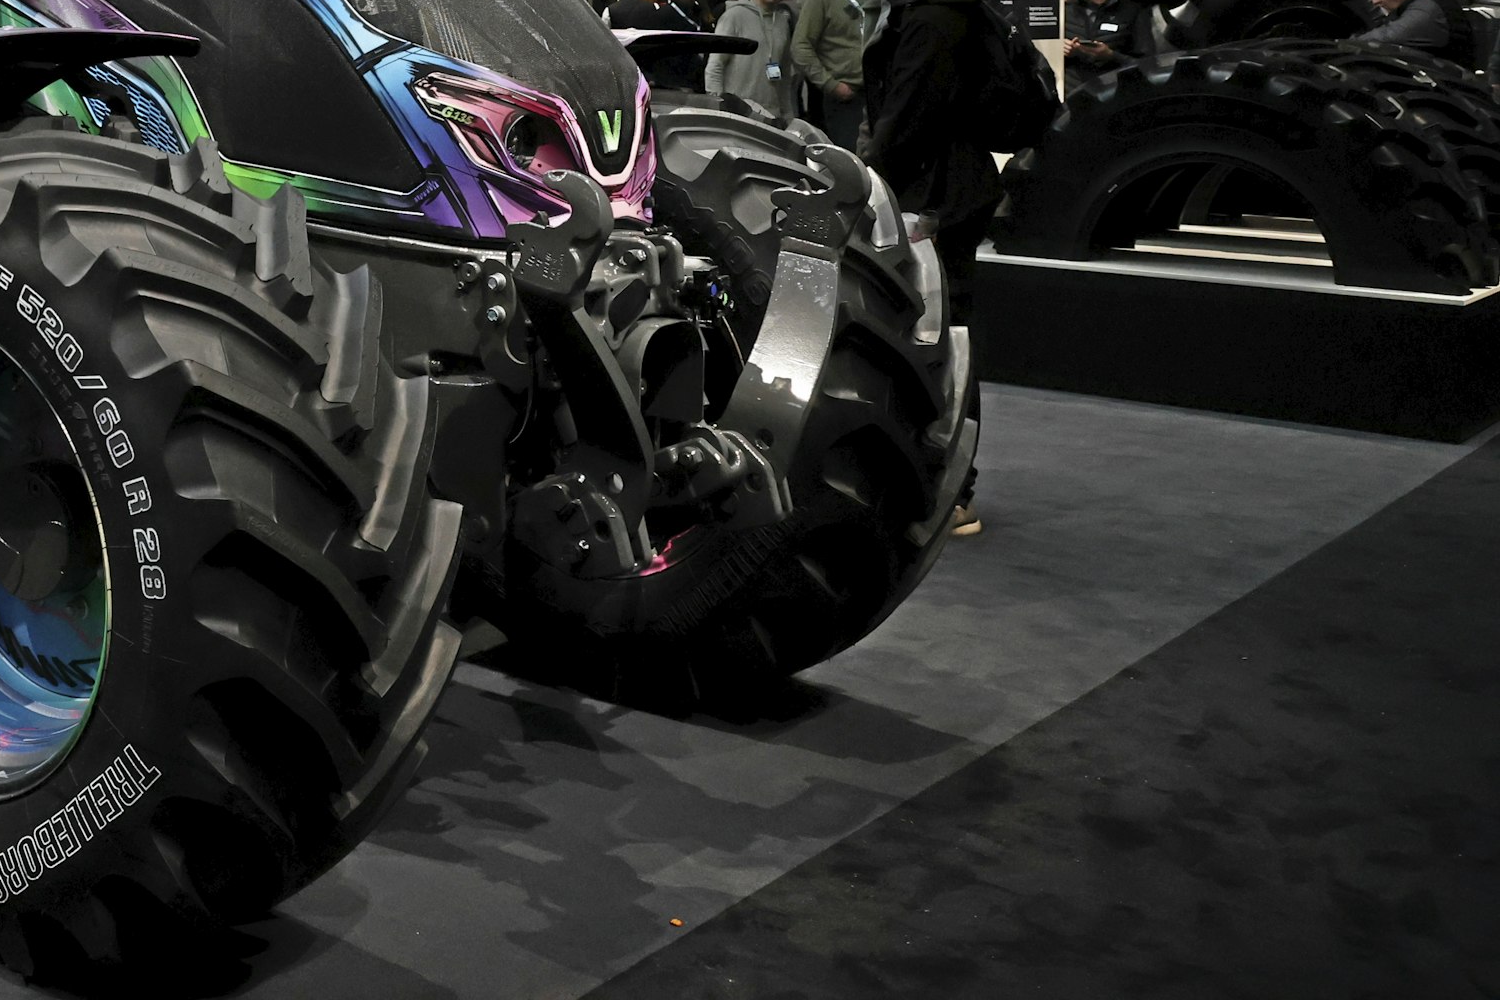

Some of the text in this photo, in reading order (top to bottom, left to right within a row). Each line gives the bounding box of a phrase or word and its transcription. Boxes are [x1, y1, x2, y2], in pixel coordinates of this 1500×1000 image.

[441, 106, 475, 125] G135
[16, 284, 136, 470] 520/60
[123, 477, 153, 516] R
[132, 528, 168, 602] 28
